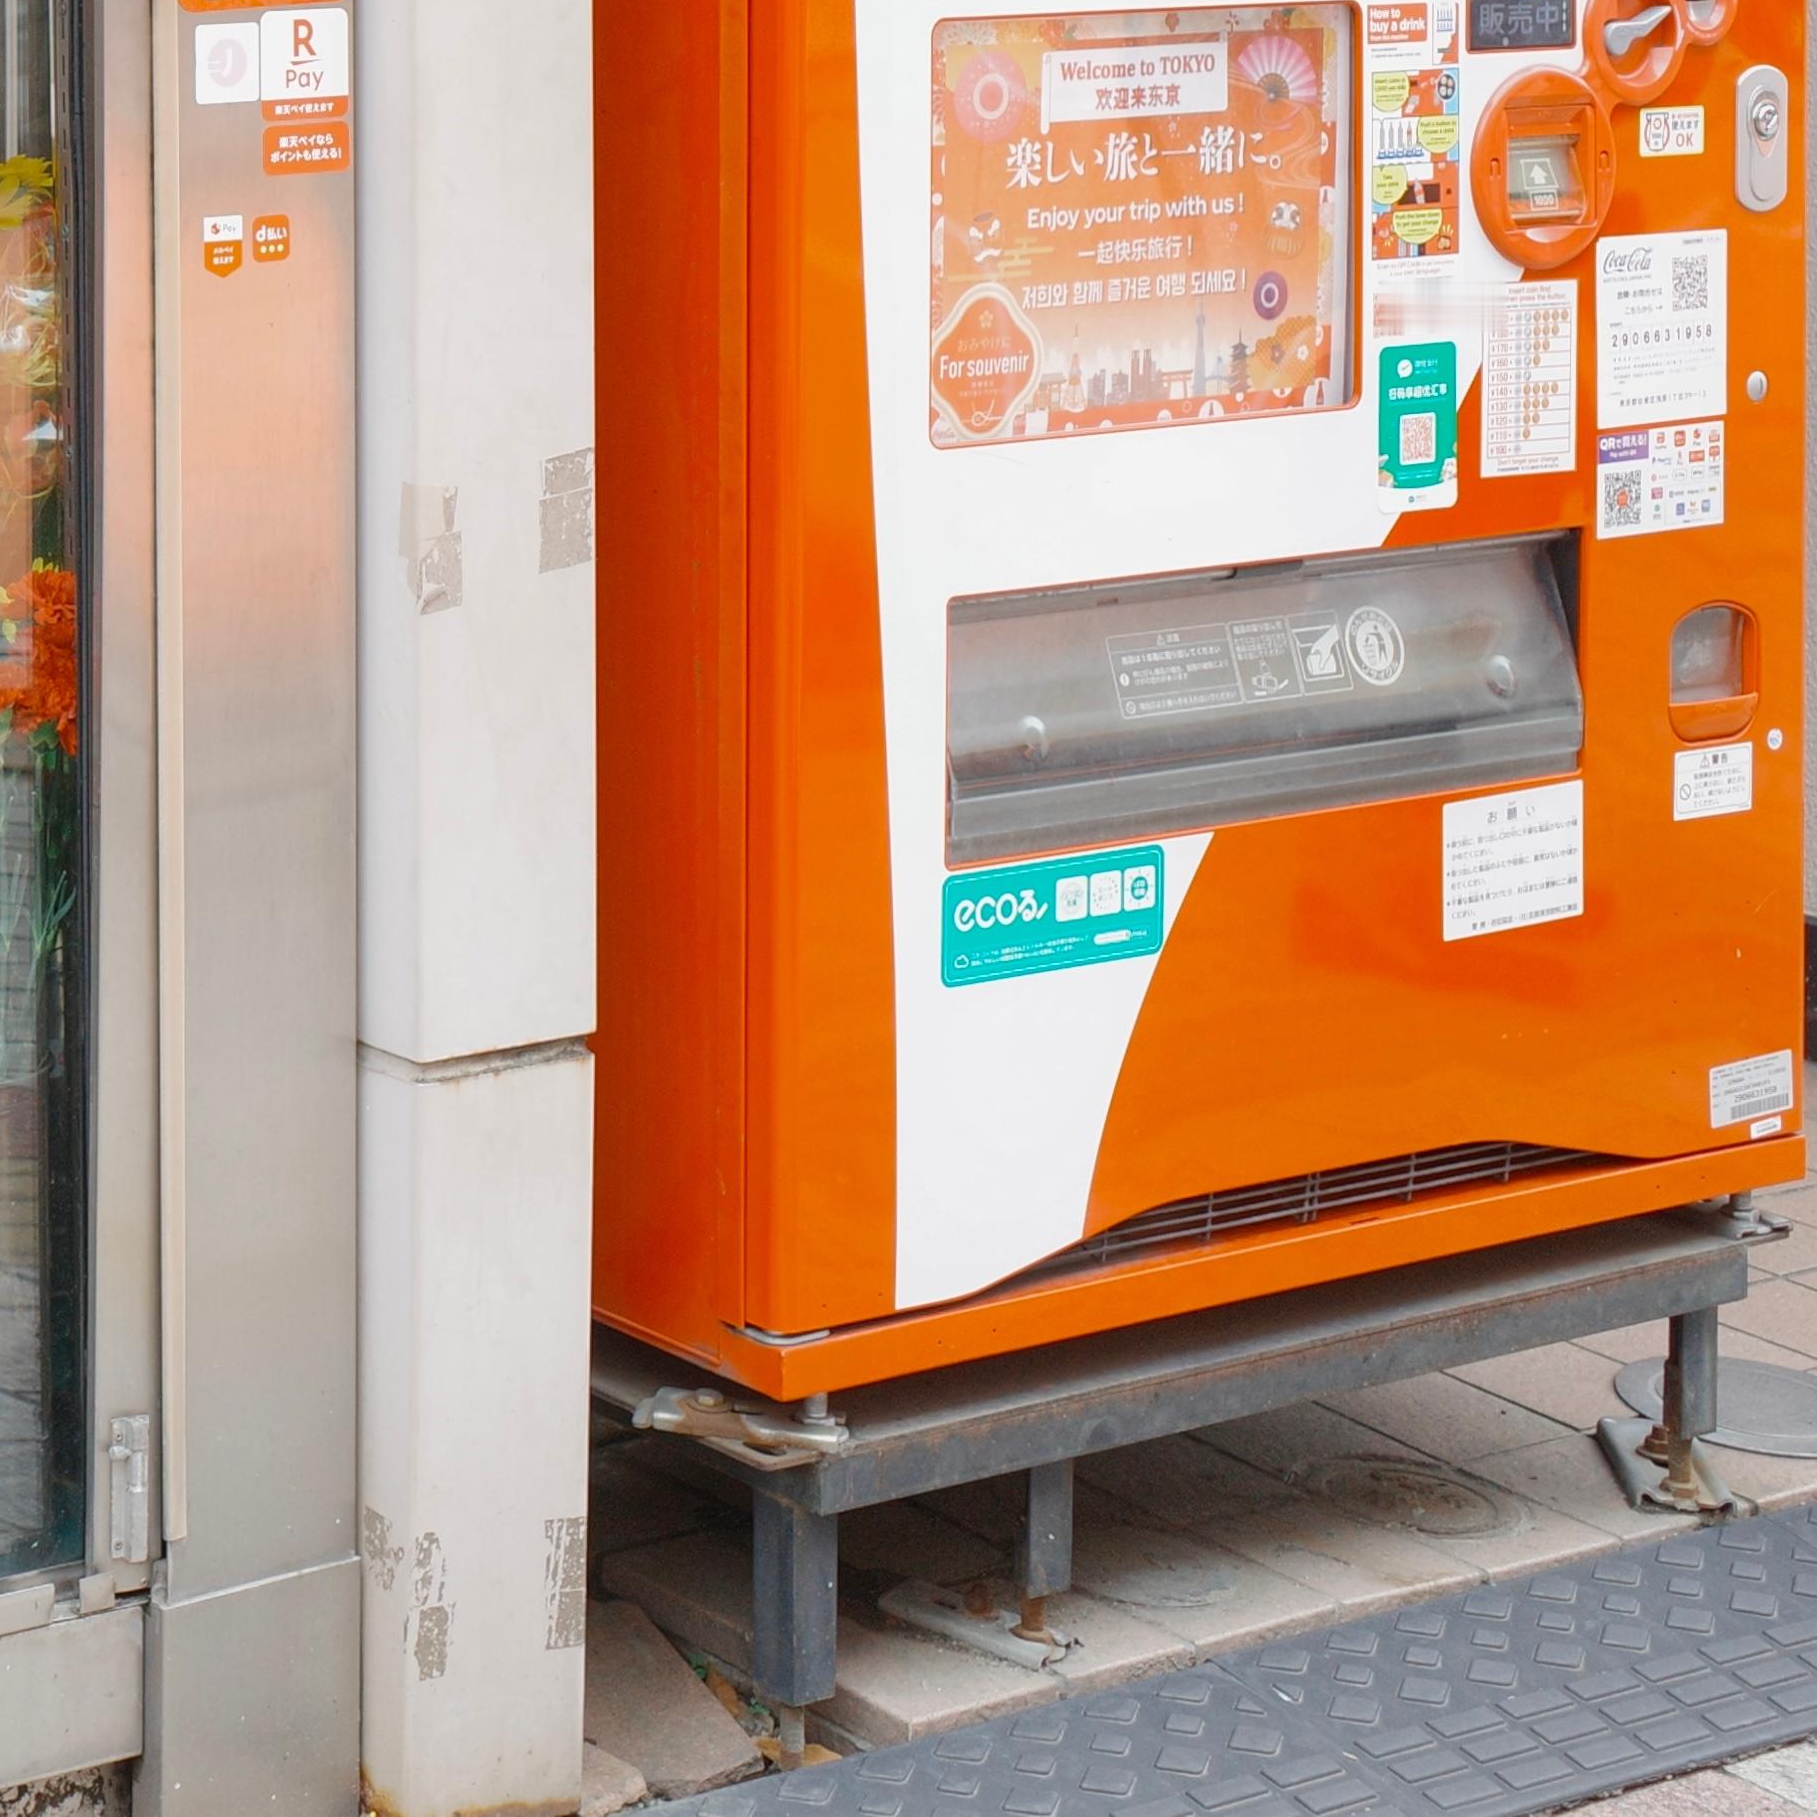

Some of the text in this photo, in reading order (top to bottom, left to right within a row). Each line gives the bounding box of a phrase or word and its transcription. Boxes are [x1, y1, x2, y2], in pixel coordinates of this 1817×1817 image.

[1370, 8, 1401, 20] How to
[1370, 21, 1388, 34] buy
[1400, 17, 1426, 31] drink
[1479, 2, 1559, 34] 販売中
[285, 69, 324, 91] Pay
[1061, 53, 1216, 82] Welcome to TOKYO
[1095, 83, 1182, 112] 欢迎来东京
[1675, 133, 1694, 147] OK
[1005, 125, 1282, 190] 楽しい旅と一緒に。
[1028, 197, 1234, 231] Enjoy your trip with us
[1022, 283, 1067, 310] 저희와
[1073, 280, 1103, 306] 함께
[939, 352, 1030, 380] For souvenir
